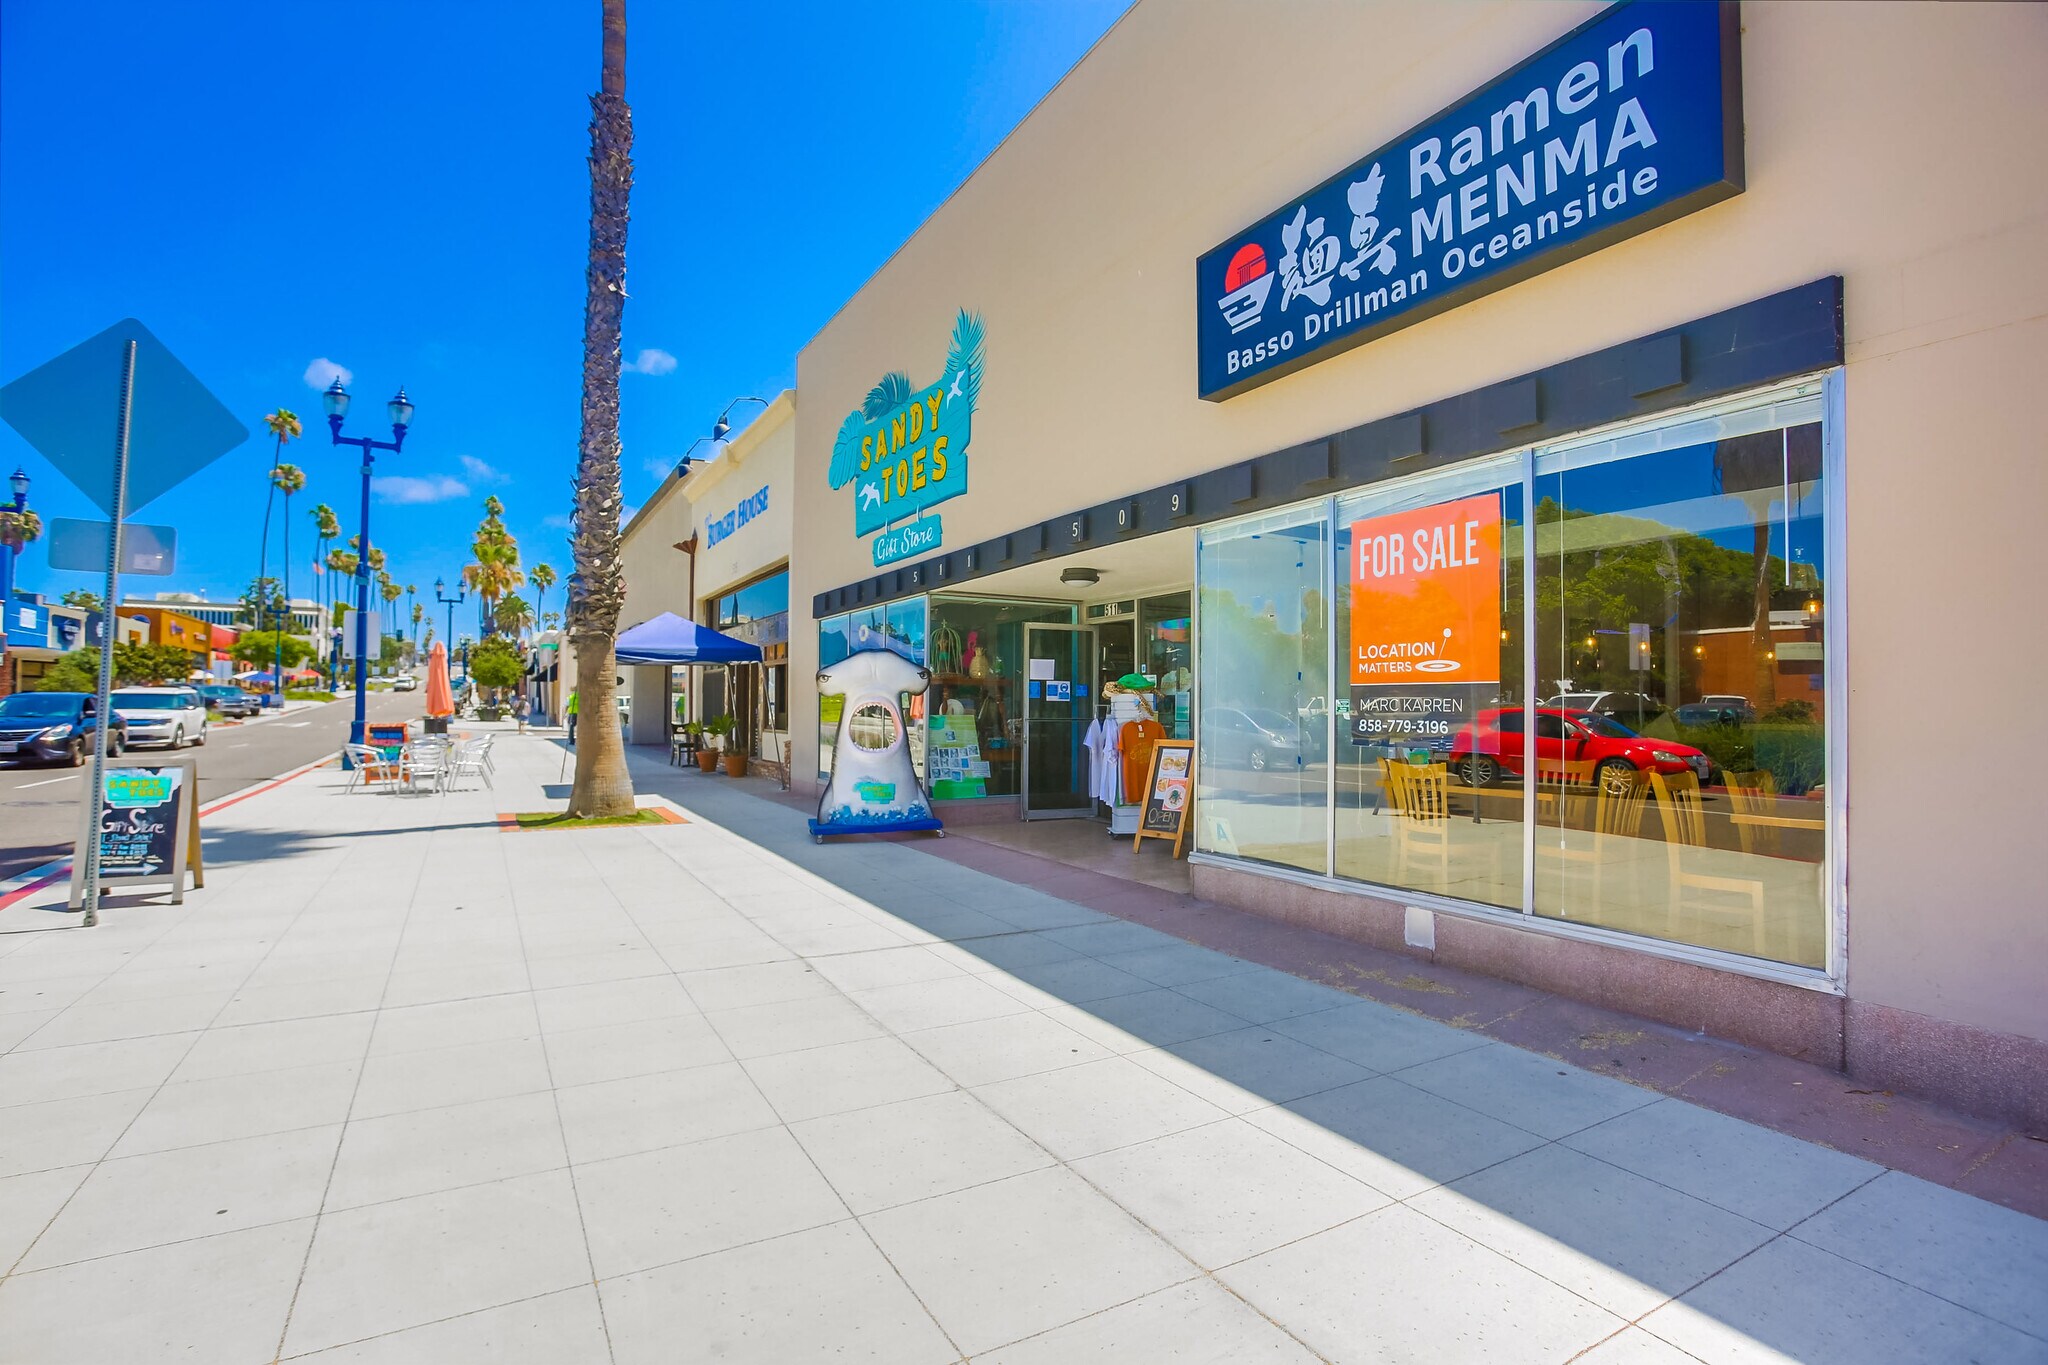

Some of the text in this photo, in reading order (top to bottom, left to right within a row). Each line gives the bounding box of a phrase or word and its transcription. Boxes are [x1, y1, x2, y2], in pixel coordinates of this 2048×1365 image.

[1410, 27, 1654, 199] Ramen
[1411, 97, 1658, 258] MENMA
[1227, 166, 1658, 375] Basso Drillman Oceanside
[860, 388, 944, 471] SANDY
[881, 436, 948, 503] TOES
[707, 510, 736, 550] BURGER
[737, 485, 769, 529] HOUSE
[877, 526, 934, 560] Gift Store
[1359, 520, 1479, 580] FOR SALE
[1359, 641, 1435, 660] LOCATION
[1359, 661, 1412, 674] MATTERS
[1358, 719, 1449, 735] 858-779-3196
[1360, 698, 1399, 712] MARC
[1403, 698, 1463, 713] KARREN
[1148, 808, 1175, 824] OPEN
